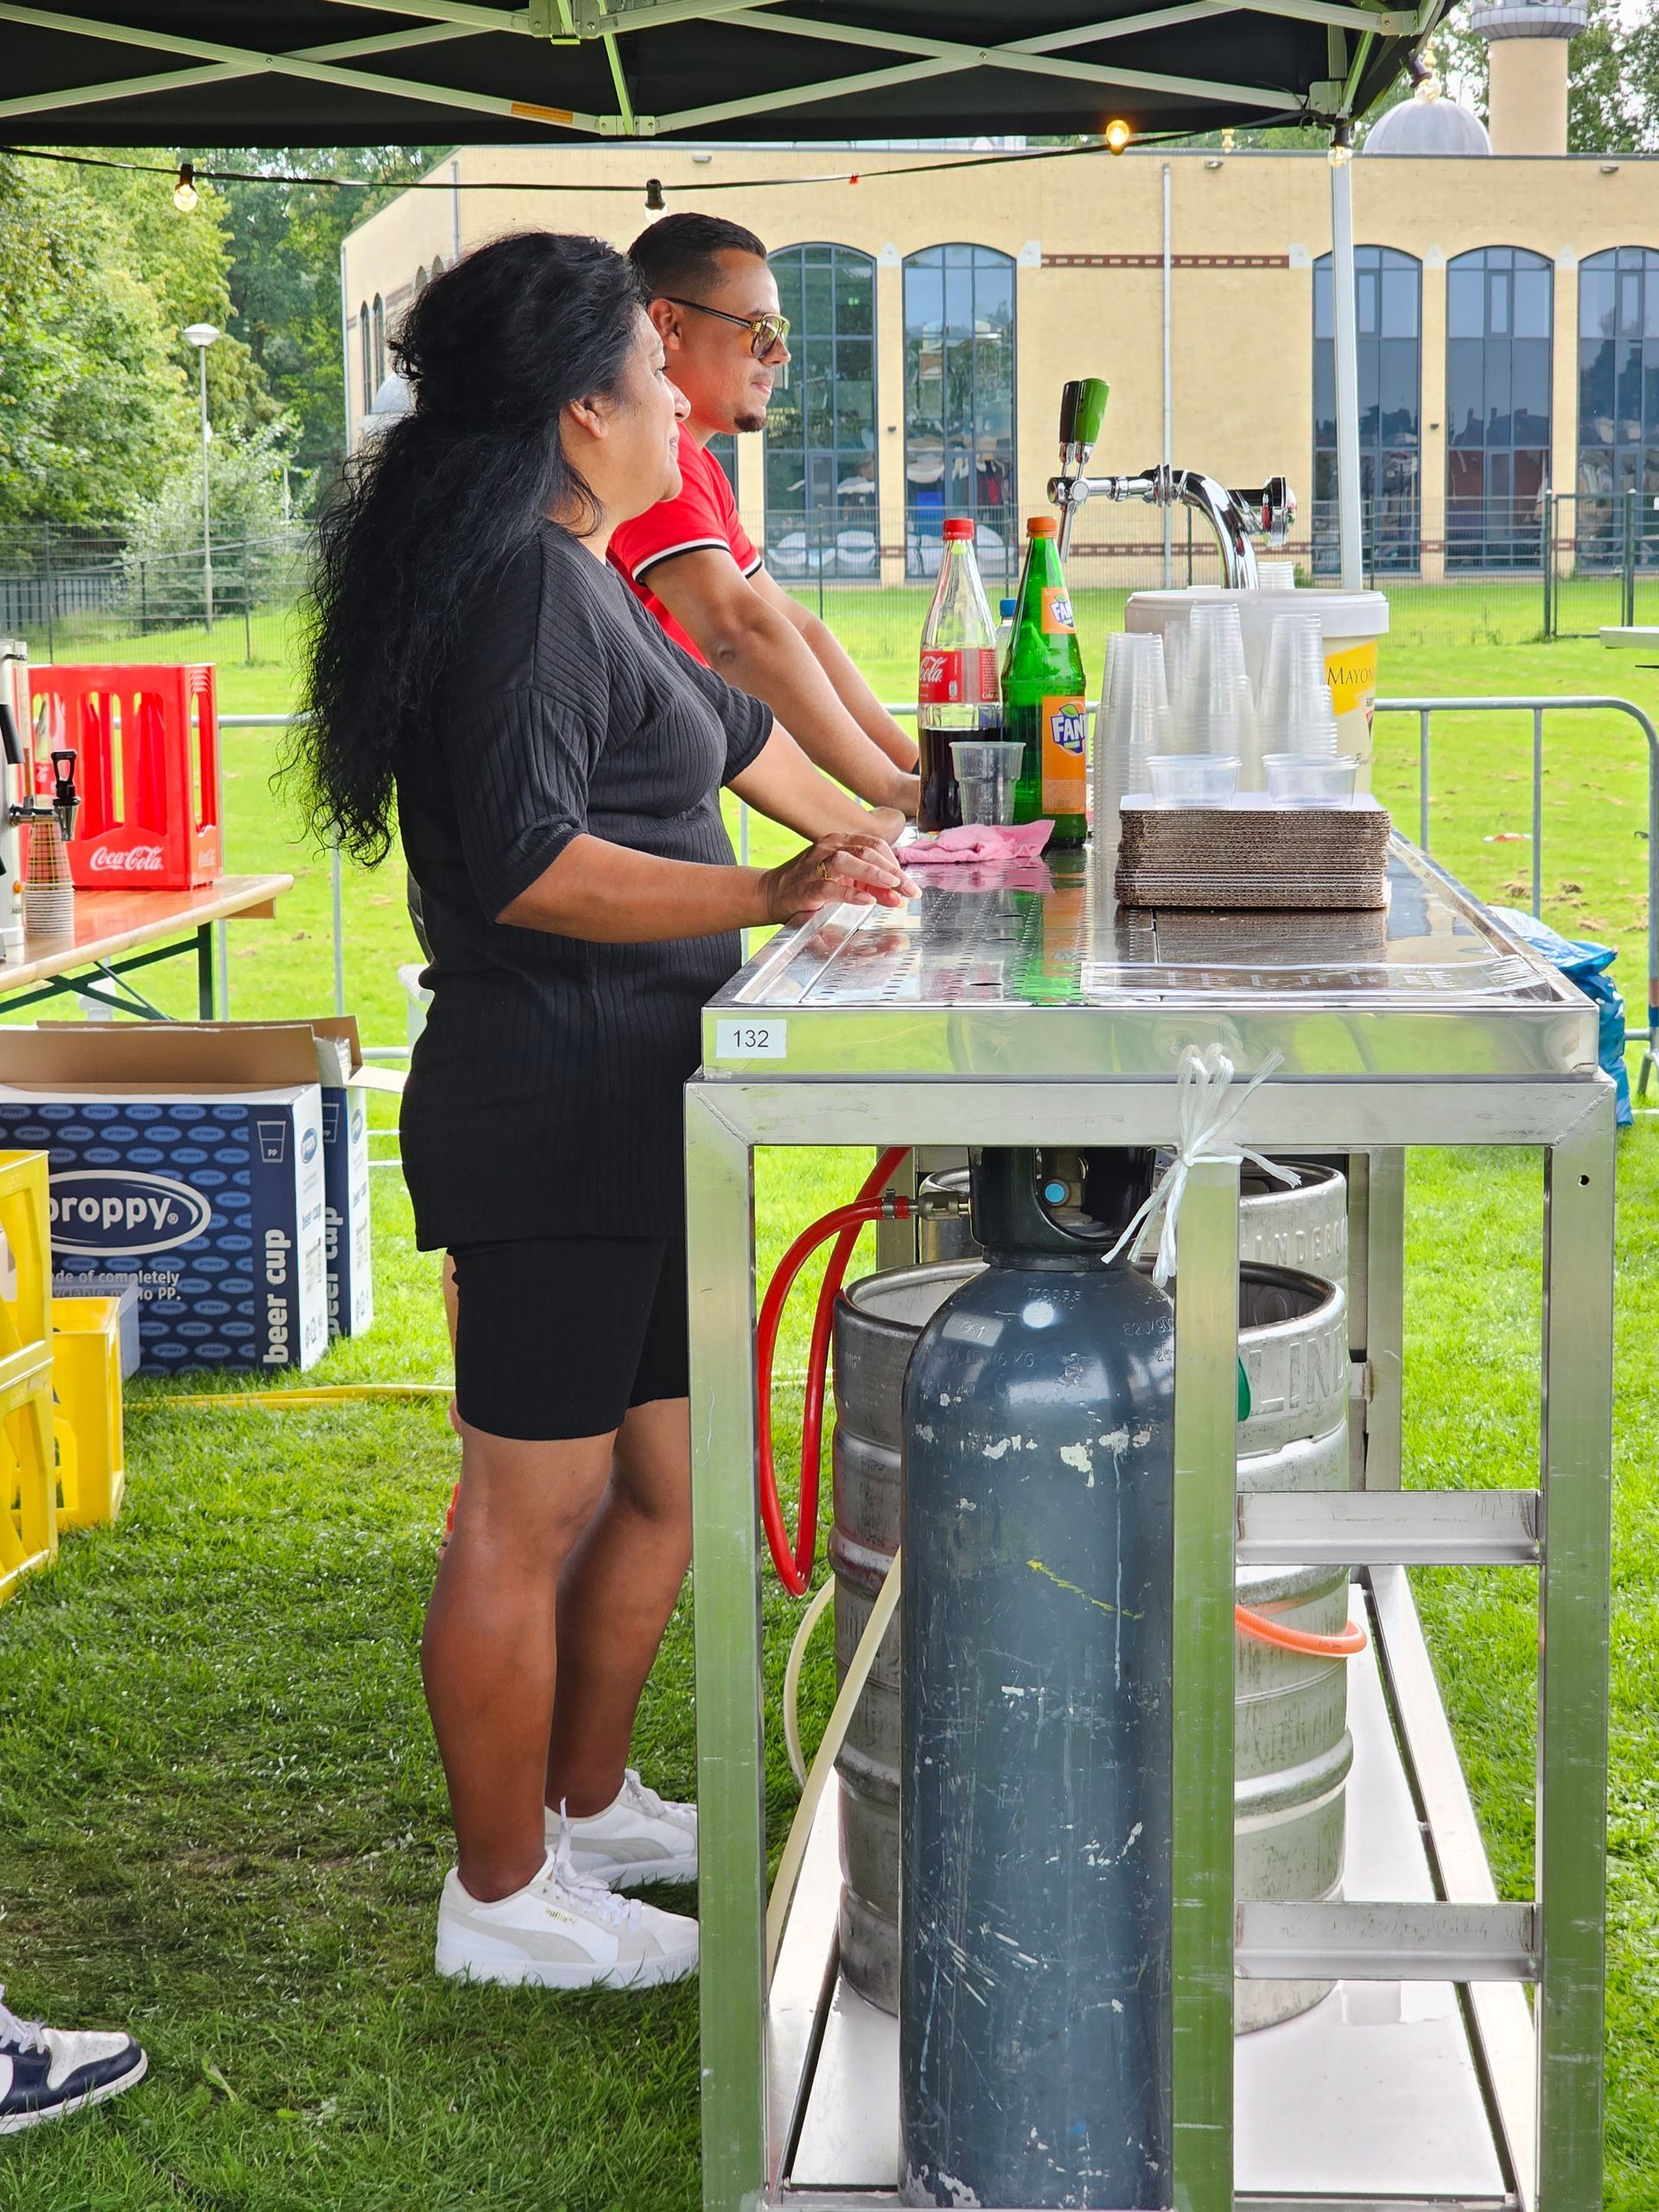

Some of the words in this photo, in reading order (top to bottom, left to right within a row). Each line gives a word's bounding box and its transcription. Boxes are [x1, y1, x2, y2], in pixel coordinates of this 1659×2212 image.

[90, 846, 164, 871] Coca-Cola
[733, 1029, 769, 1048] 132
[79, 1269, 95, 1282] of
[264, 1229, 292, 1286] cup
[263, 1294, 289, 1363] beer
[1249, 1310, 1348, 1416] LIND
